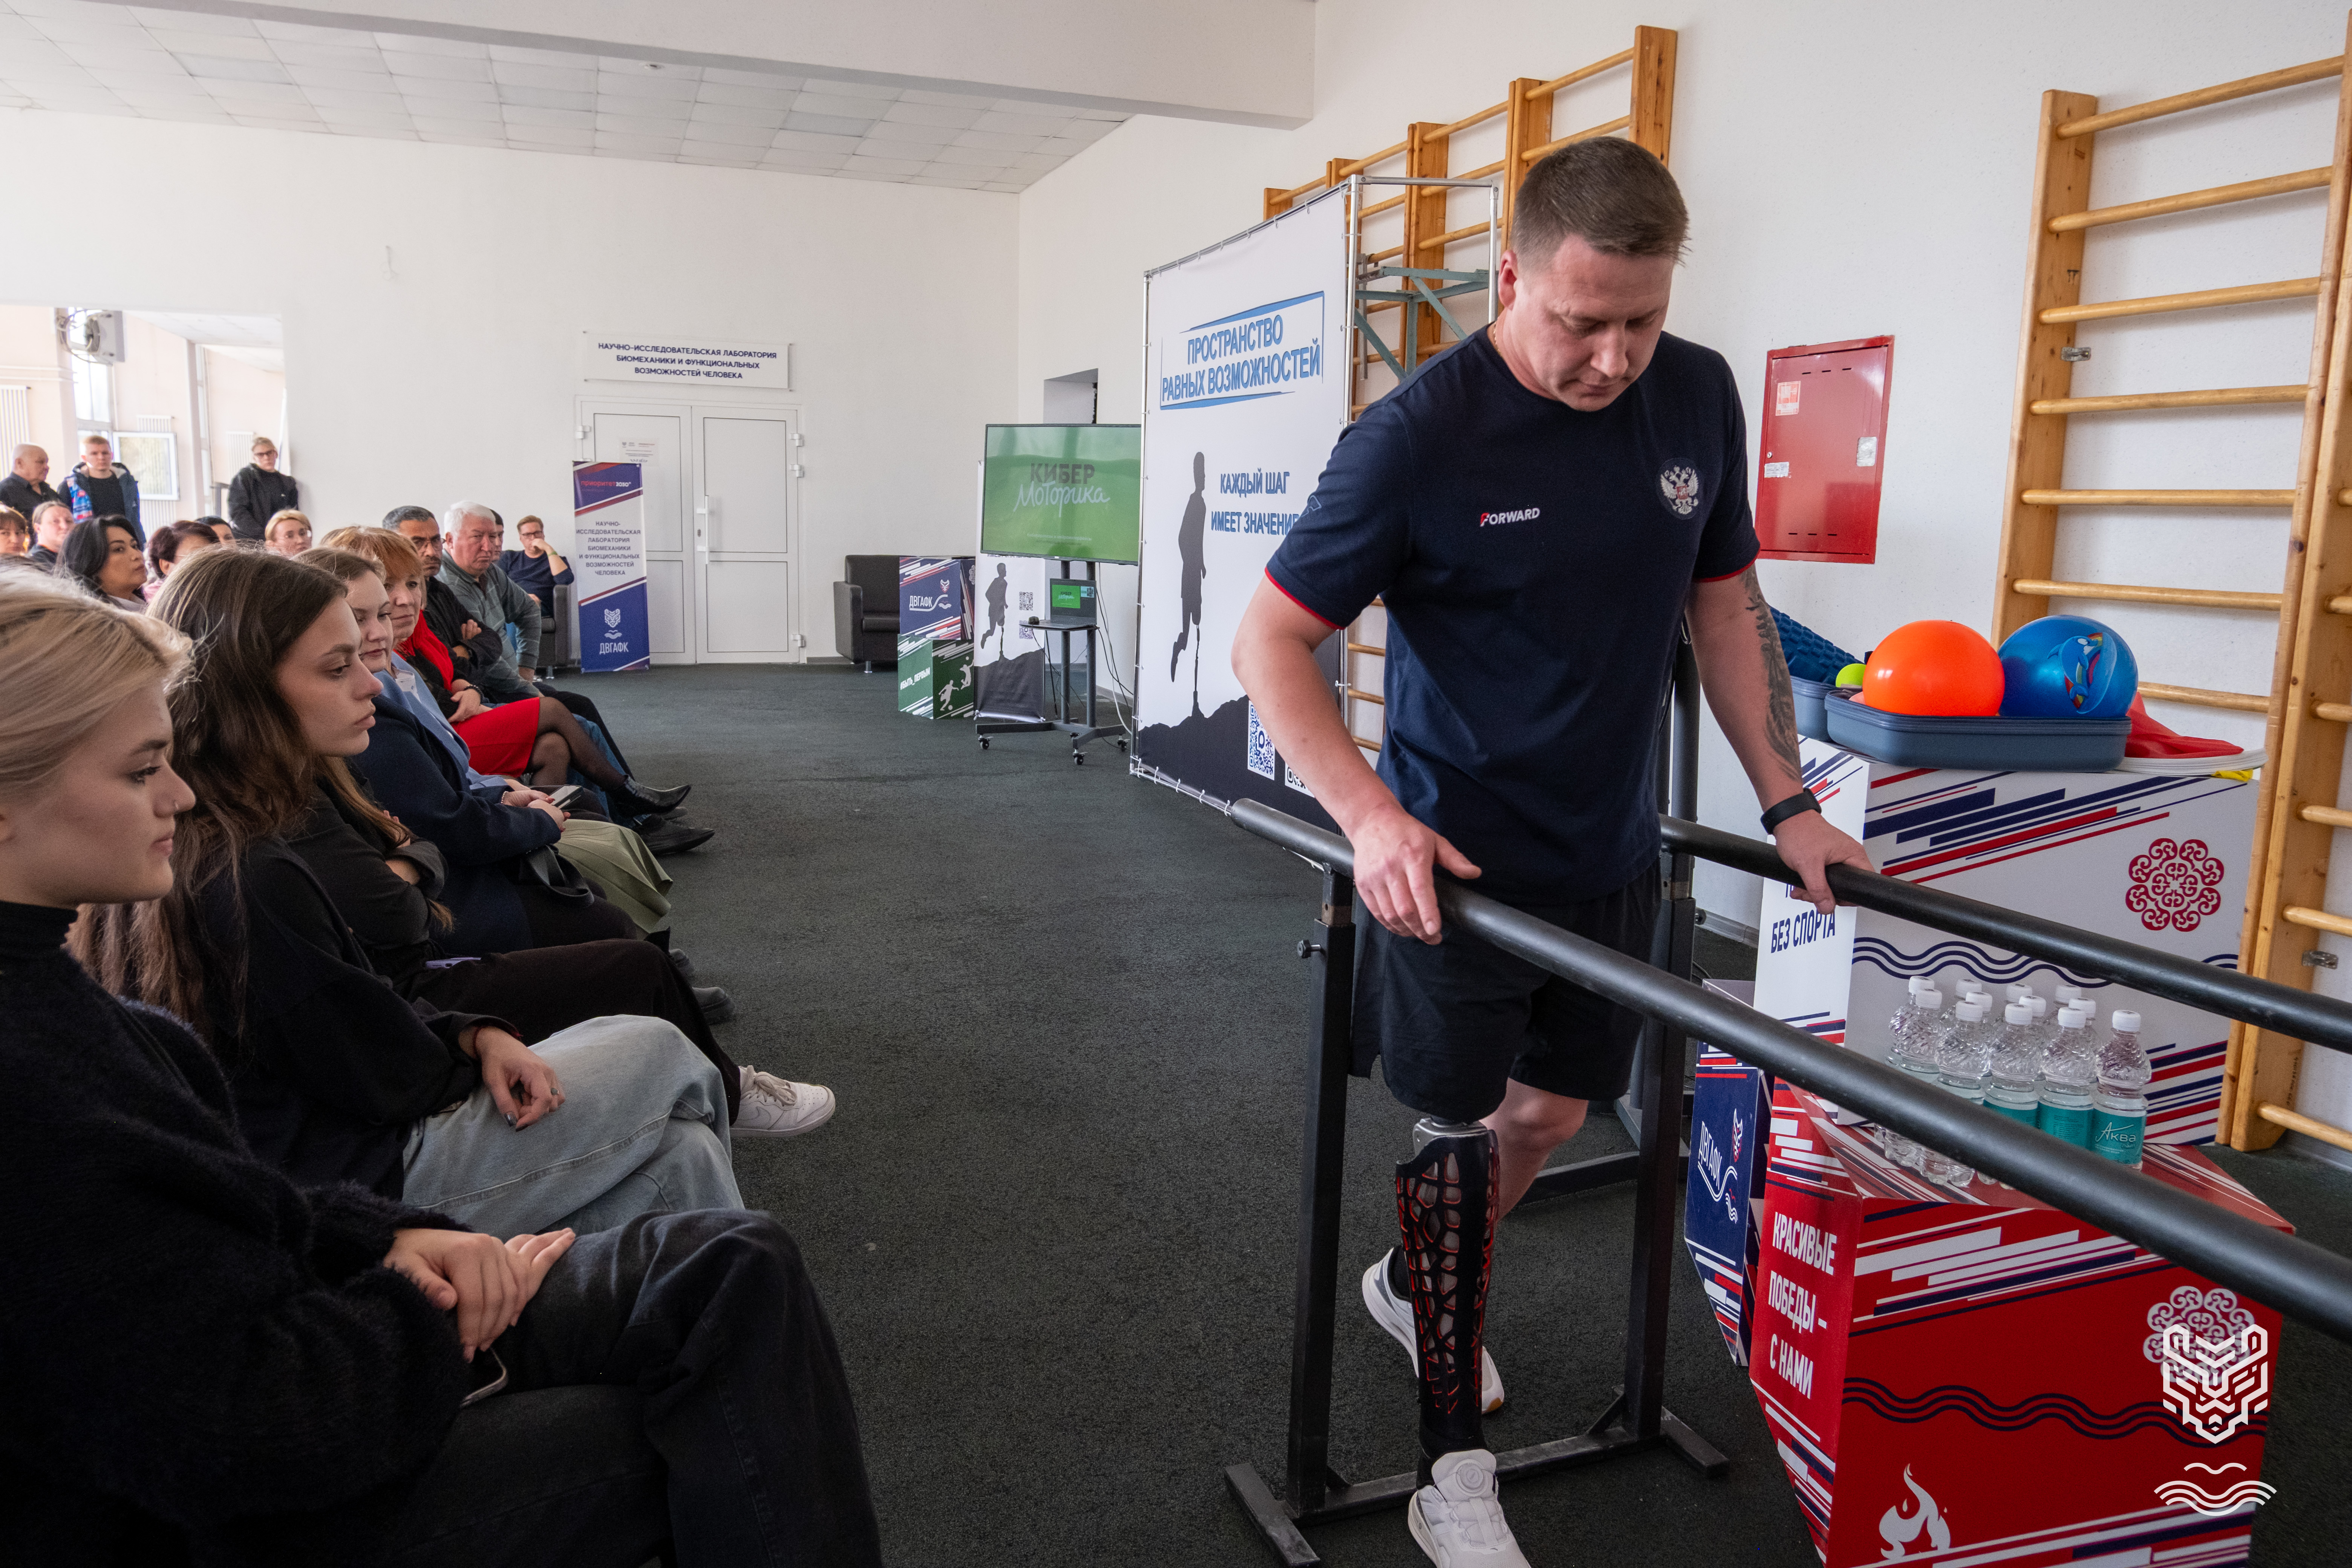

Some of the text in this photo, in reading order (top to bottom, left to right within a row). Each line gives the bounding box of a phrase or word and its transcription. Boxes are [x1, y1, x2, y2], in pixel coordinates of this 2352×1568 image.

[598, 343, 777, 359] НАУЧНО-ИССЛЕДОВАТЕЛЬСКАЯ ЛАБОРАТОРИЯ
[1188, 314, 1283, 364] ПРОСТРАНСТВО
[617, 355, 675, 364] БИОМЕХАНИКИ
[685, 359, 760, 369] ФУНКЦИОНАЛЬНЫХ
[635, 367, 701, 376] ВОЗМОЖНОСТЕЙ
[1162, 338, 1320, 401] РАВНЫХ ВОЗМОЖНОСТЕЙ
[1031, 463, 1095, 484] КИБЕР
[1220, 467, 1289, 498] КАЖДЫЙ ШАГ
[1013, 481, 1110, 518] Моторика
[1211, 511, 1242, 532] ИМЕЕТ
[1480, 508, 1540, 527] FORWARD
[909, 596, 933, 608] ДВГАФК
[599, 642, 629, 655] ДВГАФК
[1771, 918, 1790, 953] БЕЗ
[2096, 1122, 2136, 1142] Аква
[1698, 1121, 1722, 1190] ДВГАФК
[1772, 1211, 1837, 1276] КРАСИВЫЕ
[1768, 1270, 1816, 1334] ПОБЕДЫ
[1770, 1334, 1813, 1400] С НАМИ
